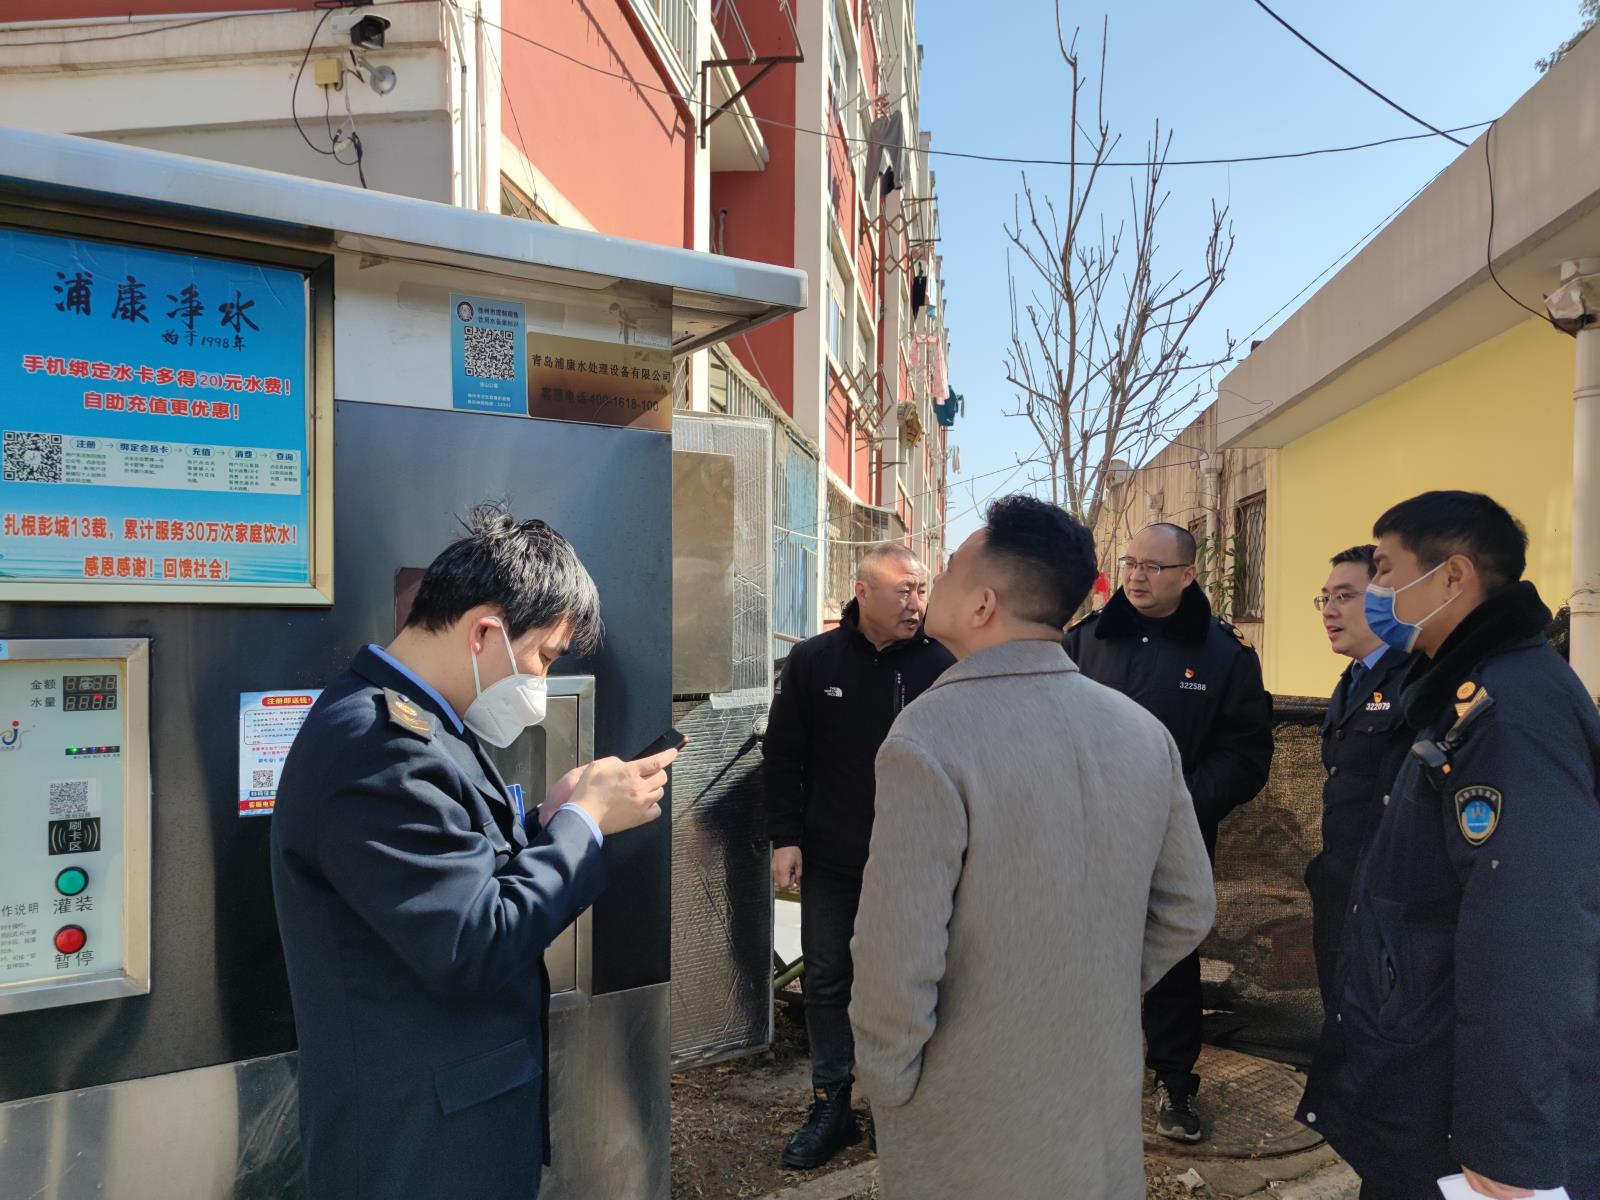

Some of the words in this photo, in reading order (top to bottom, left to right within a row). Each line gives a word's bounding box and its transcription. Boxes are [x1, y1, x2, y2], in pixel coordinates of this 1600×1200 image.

[54, 272, 260, 332] 浦康净水
[161, 330, 247, 352] 始于1998年
[531, 353, 671, 383] 青岛浦康水处理设备有限公司
[83, 391, 240, 421] 自助充值更优惠！
[31, 679, 56, 690] 金额
[31, 697, 56, 708] 水量
[1, 902, 39, 917] 作说明
[53, 896, 93, 915] 灌装
[55, 950, 94, 969] 暂停
